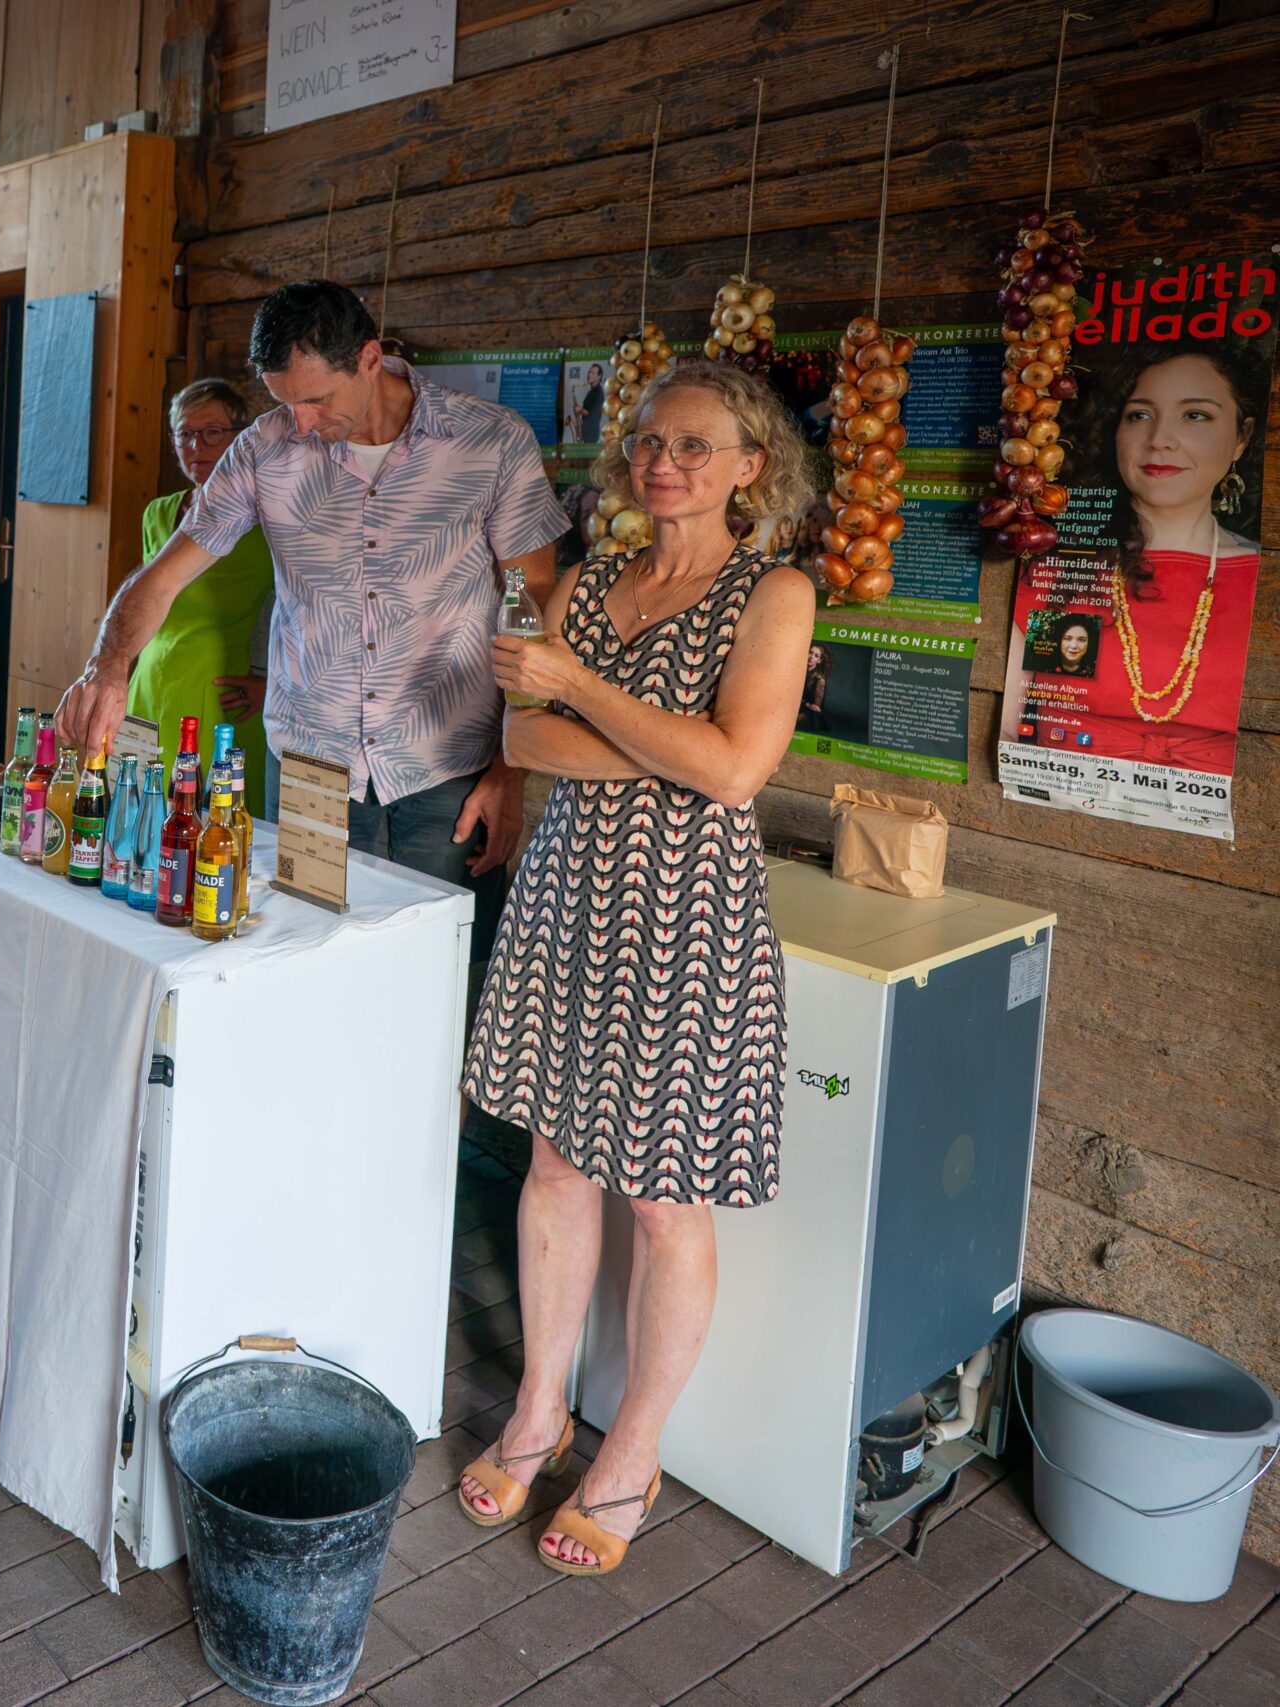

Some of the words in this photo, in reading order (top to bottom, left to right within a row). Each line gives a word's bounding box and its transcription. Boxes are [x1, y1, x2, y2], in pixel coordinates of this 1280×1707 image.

[280, 16, 326, 58] WEIN
[278, 62, 351, 109] BIONADE
[1087, 259, 1277, 316] judith
[1074, 301, 1273, 345] ellado
[1093, 499, 1113, 509] und
[1079, 536, 1095, 546] Mai
[1095, 537, 1119, 548] 2019
[1069, 595, 1090, 606] Juni
[1090, 597, 1114, 608] 2019
[829, 627, 967, 653] SOMMERKONZERTE
[875, 650, 902, 662] LAURA
[999, 752, 1085, 779] Samstag,
[1096, 768, 1126, 784] 23.
[1133, 773, 1169, 791] Mai
[1174, 780, 1228, 801] 2020
[1137, 763, 1167, 775] Eintritt
[1188, 771, 1227, 785] Kollekte
